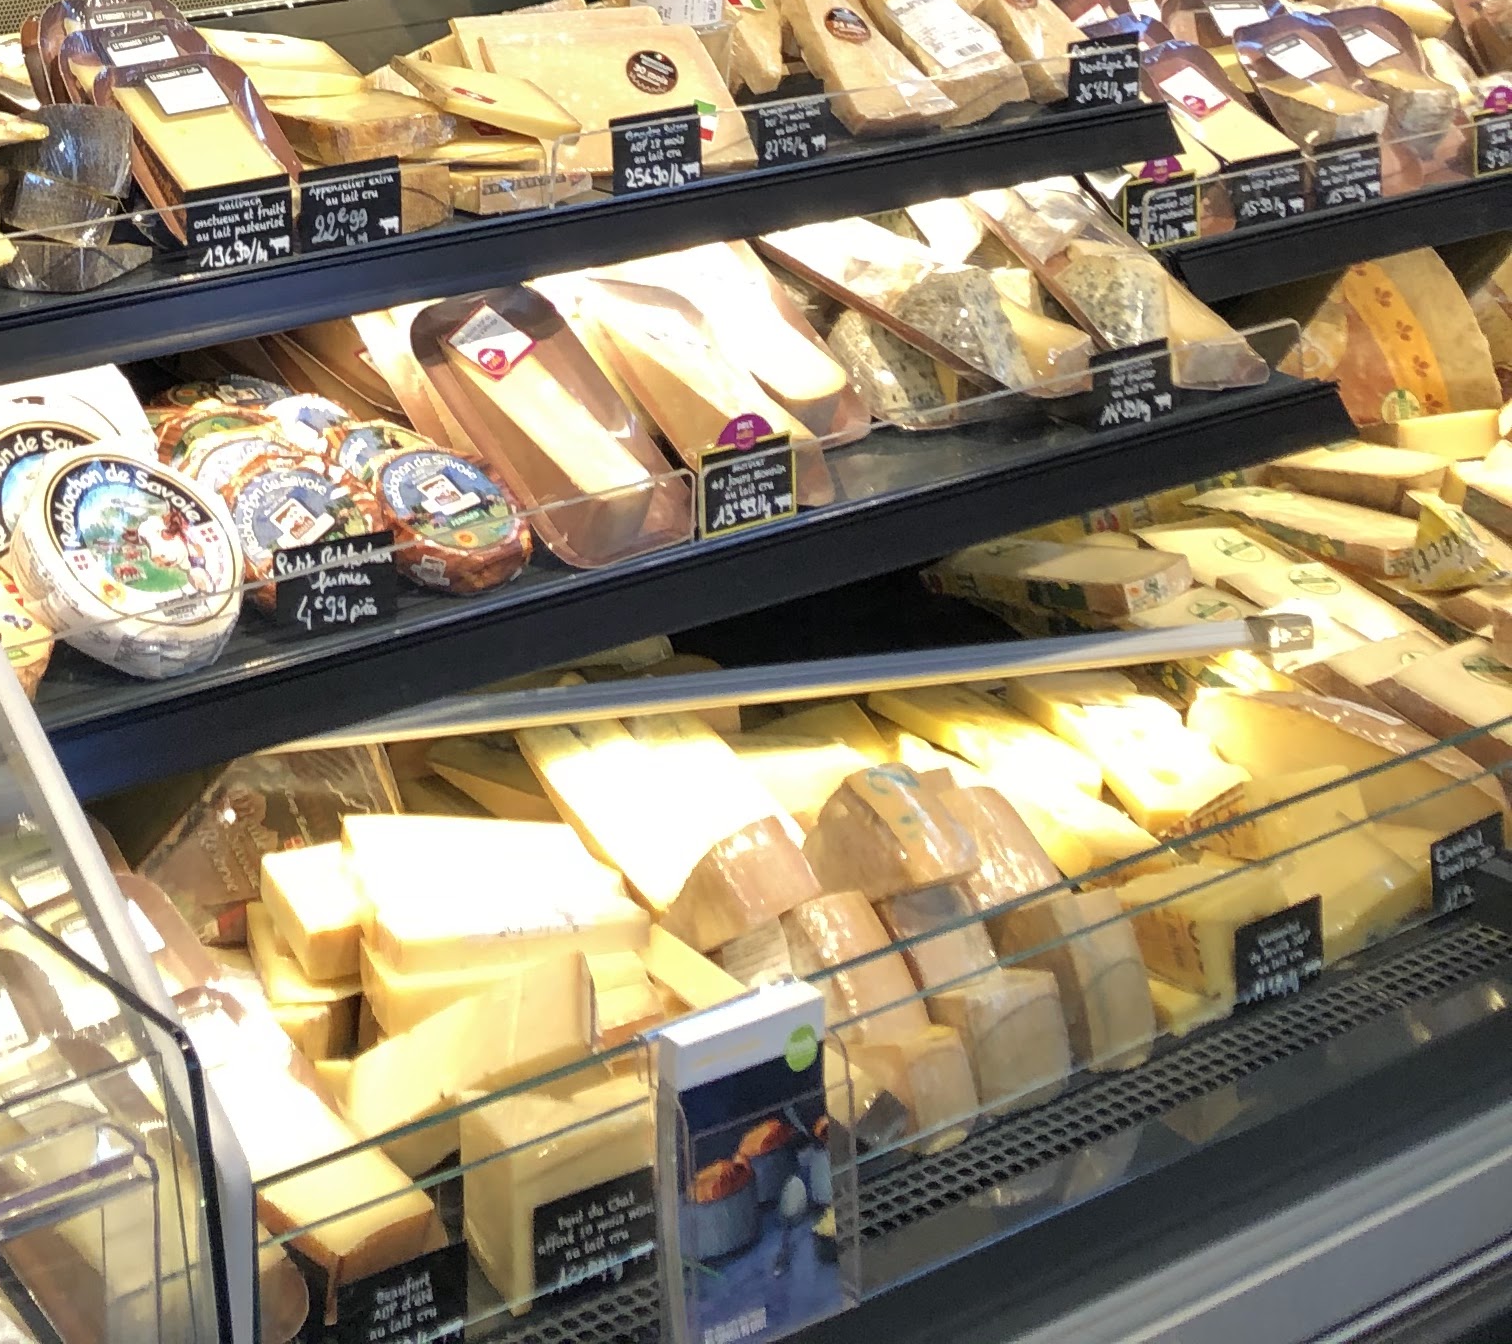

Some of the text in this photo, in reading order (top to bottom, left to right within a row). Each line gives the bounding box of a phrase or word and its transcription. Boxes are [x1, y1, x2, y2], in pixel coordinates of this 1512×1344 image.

[308, 174, 393, 201] Appenzeller extra
[325, 190, 378, 206] au lait cru
[194, 201, 286, 229] onctueux et fruité
[196, 217, 285, 242] au lait pasteurisé
[13, 434, 39, 454] de
[54, 463, 202, 548] Reblochon de Savoie
[565, 1229, 629, 1261] au lait cru
[369, 1306, 437, 1341] au lait cru
